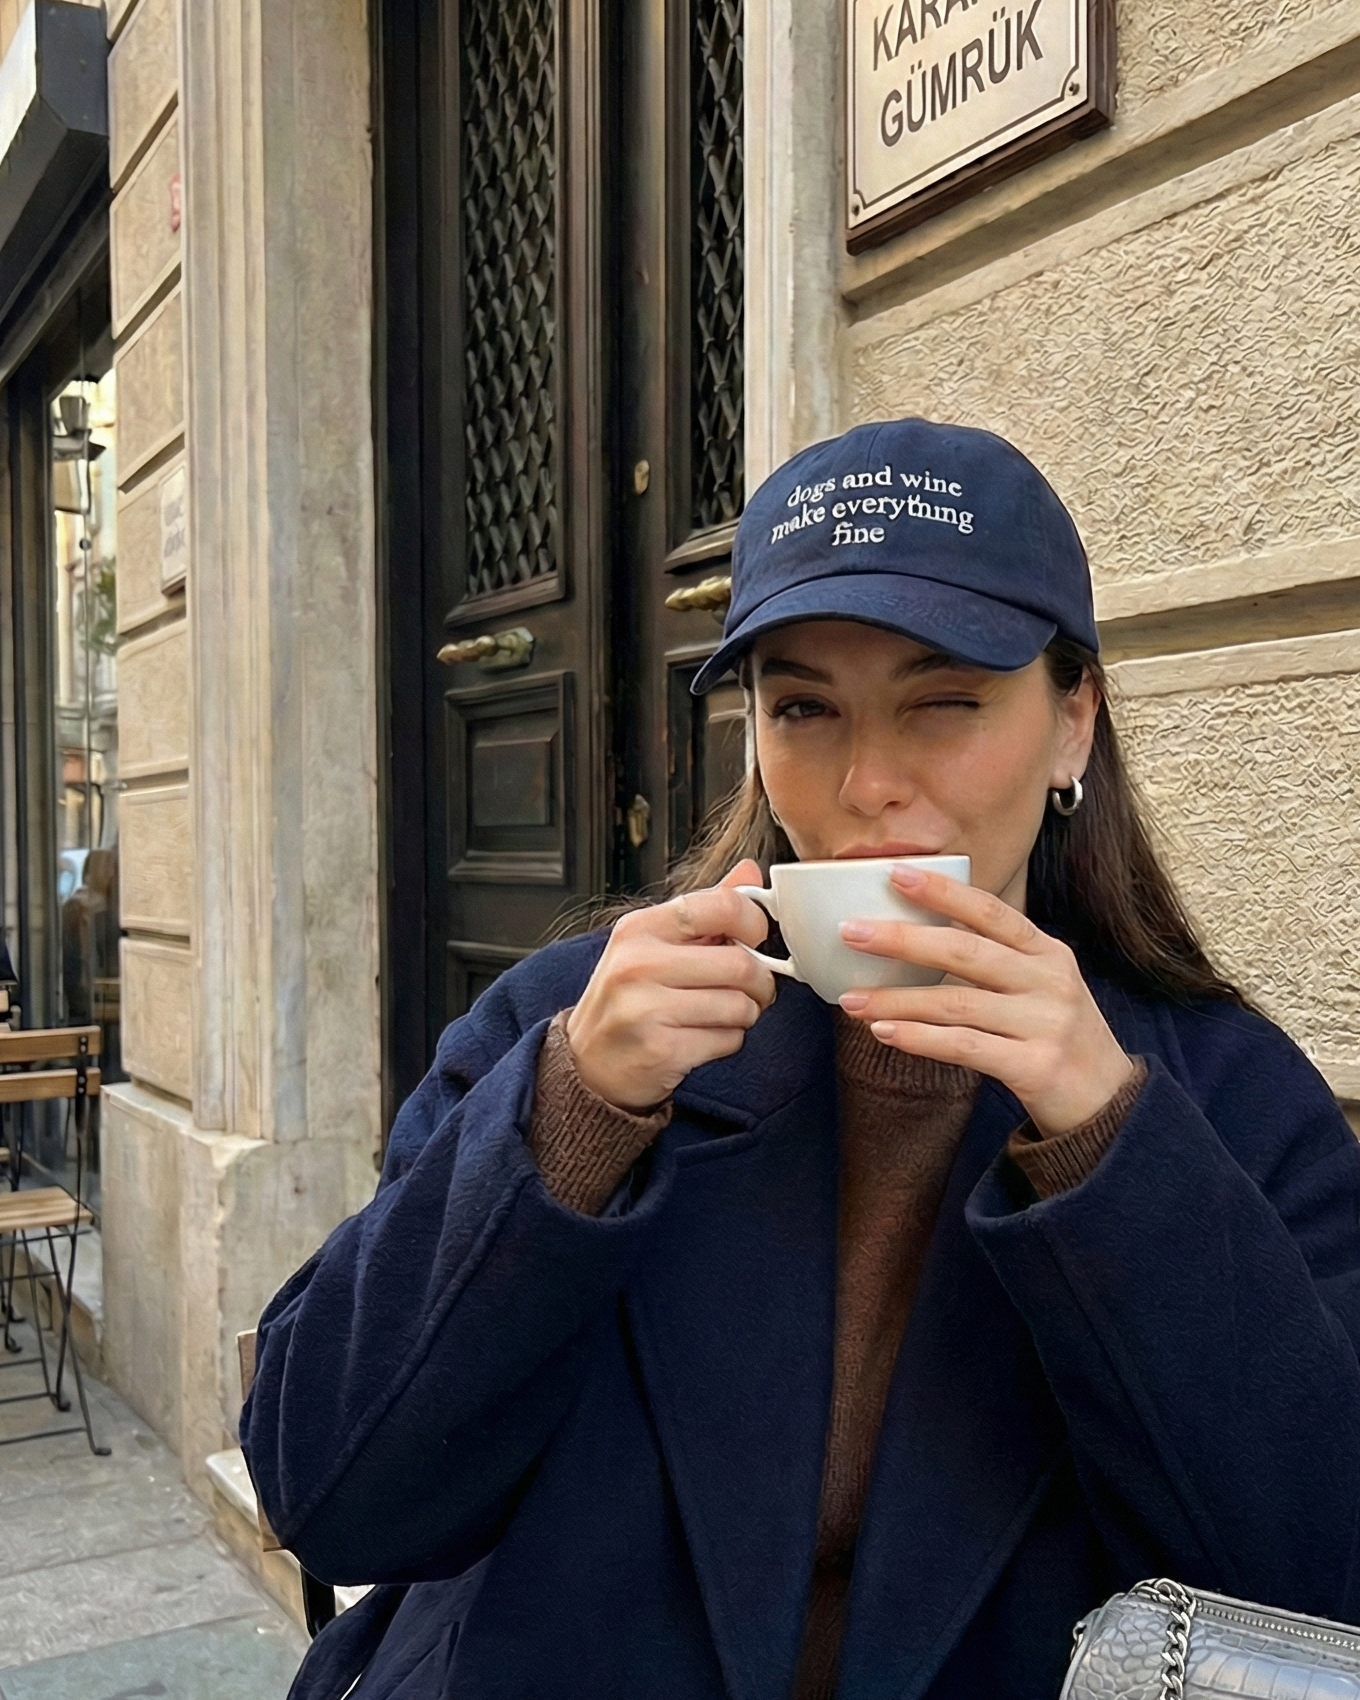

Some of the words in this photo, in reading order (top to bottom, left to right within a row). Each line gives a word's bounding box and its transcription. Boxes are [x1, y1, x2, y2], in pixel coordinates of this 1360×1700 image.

[873, 0, 979, 71] KAR
[881, 0, 1043, 147] GÜMRÜK
[787, 477, 836, 507] dogs
[842, 465, 893, 489] and
[900, 470, 963, 497] wine
[771, 503, 826, 545] make
[831, 494, 974, 534] everything
[831, 521, 885, 546] fine
